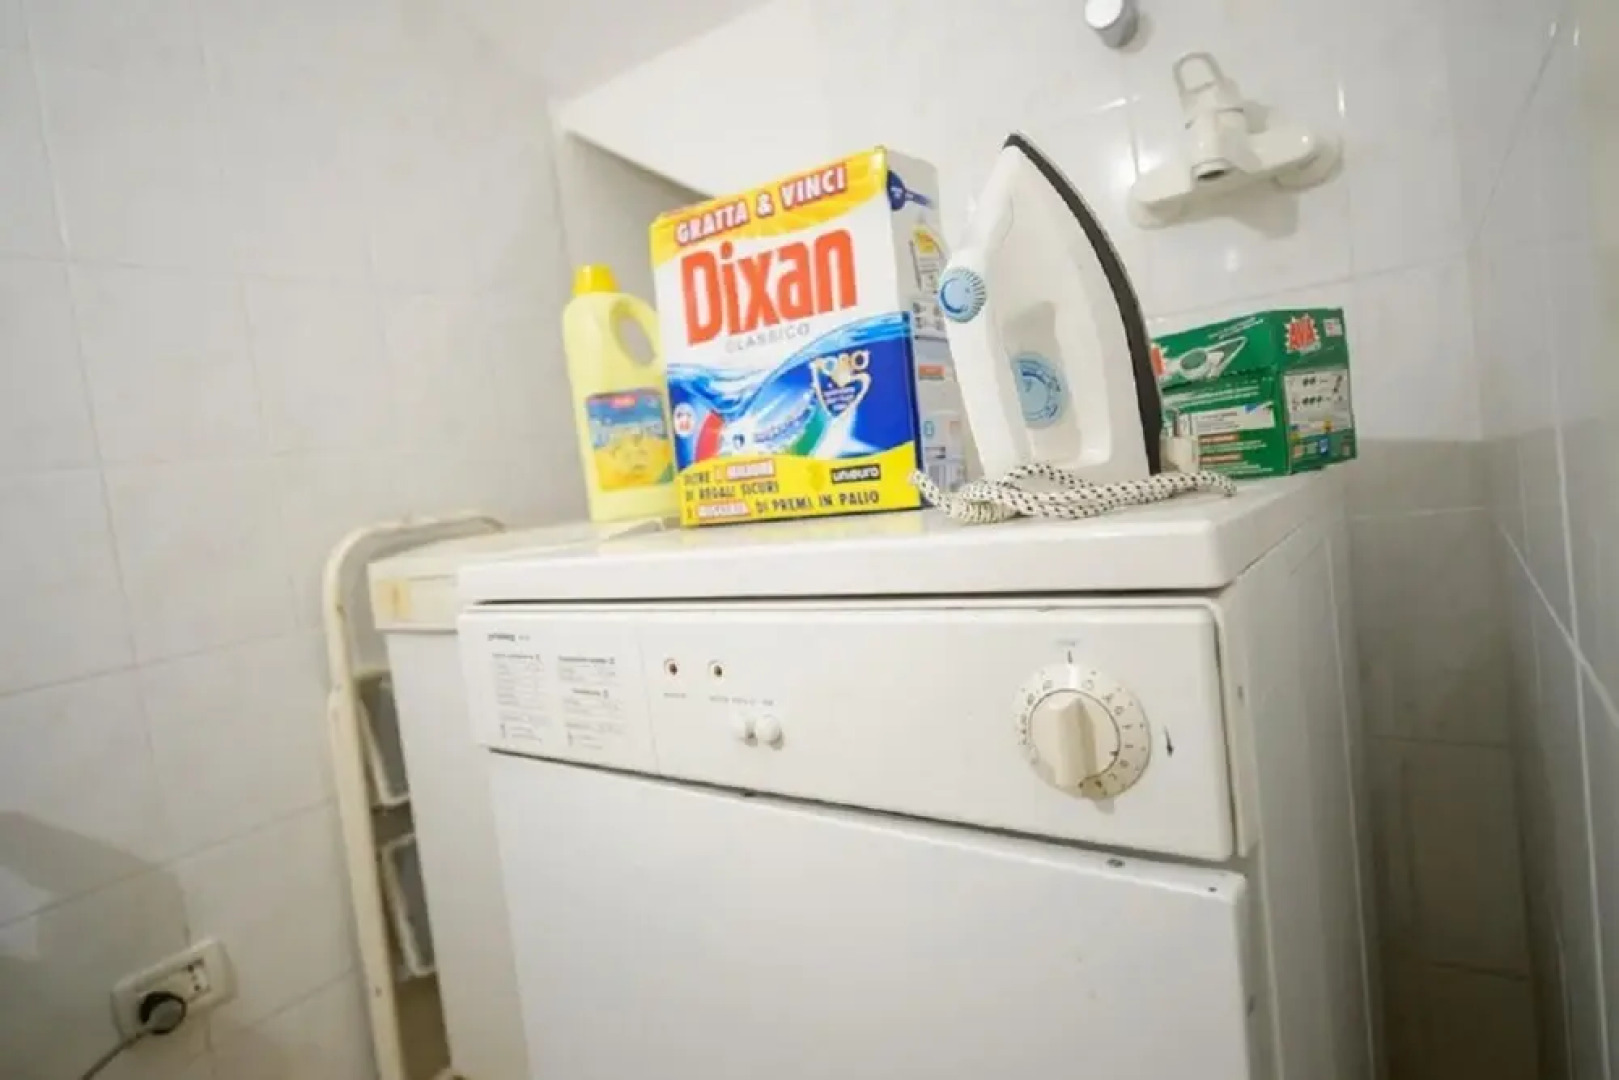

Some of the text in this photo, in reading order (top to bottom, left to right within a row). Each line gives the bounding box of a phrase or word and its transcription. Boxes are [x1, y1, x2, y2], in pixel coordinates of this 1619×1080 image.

[677, 200, 749, 246] GRATTA
[756, 191, 774, 217] &
[779, 164, 847, 210] VINCI
[681, 229, 858, 347] Dixan
[725, 323, 811, 354] CLASSICO
[772, 497, 813, 512] PREMI
[819, 493, 832, 507] IN
[840, 490, 880, 506] PALIO
